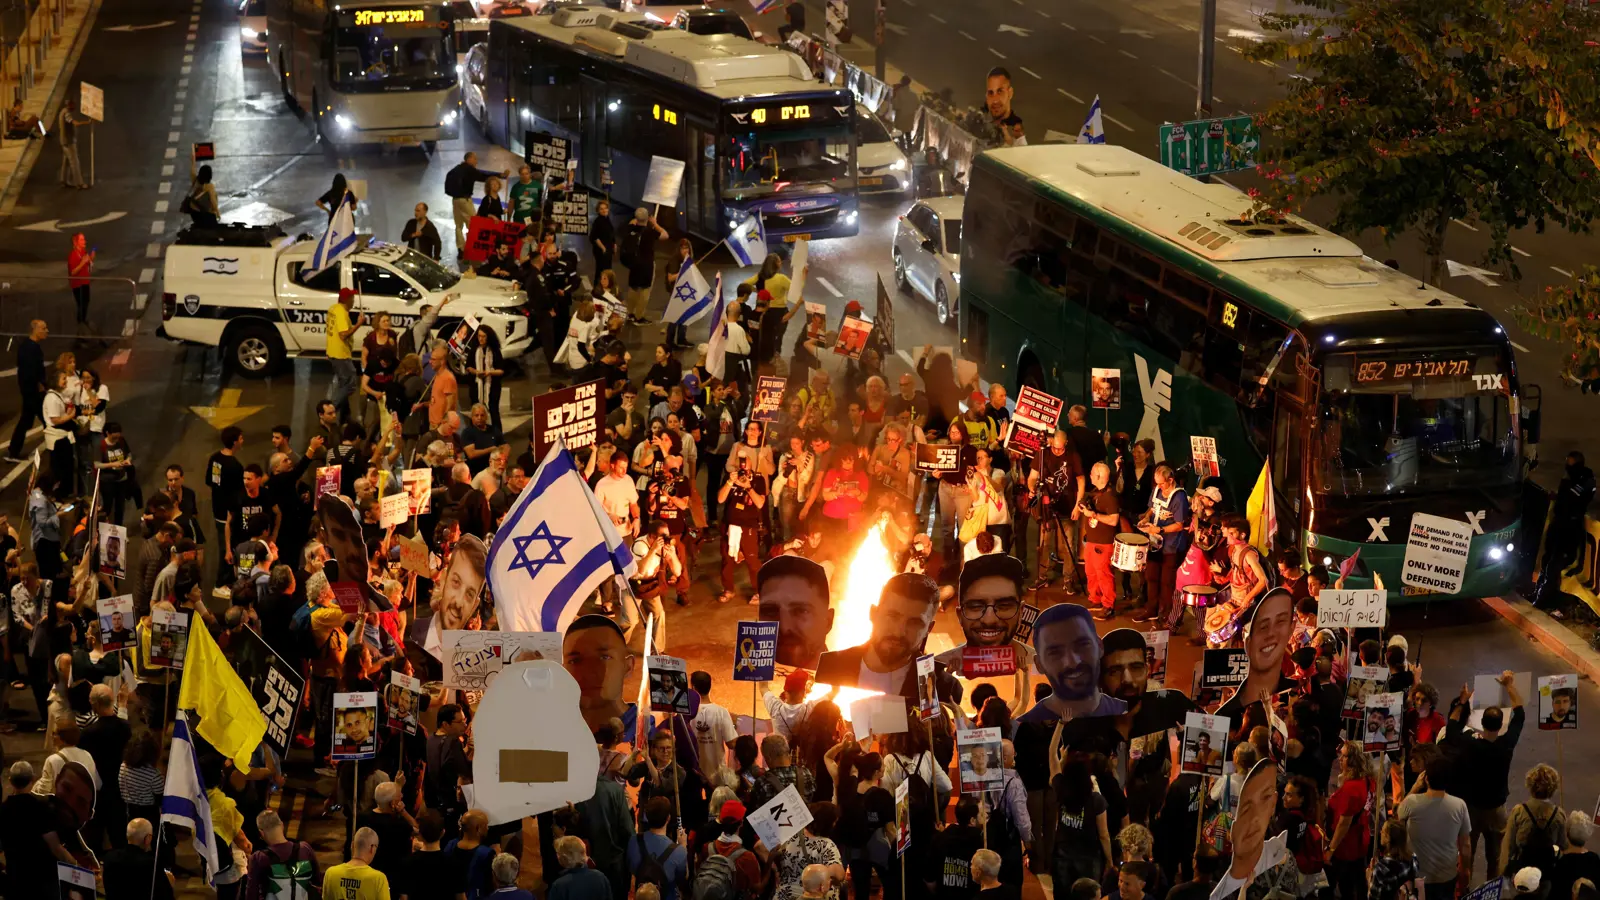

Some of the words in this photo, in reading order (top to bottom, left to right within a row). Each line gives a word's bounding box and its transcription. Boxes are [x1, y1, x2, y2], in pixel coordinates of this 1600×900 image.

[751, 108, 767, 124] 40
[552, 137, 566, 147] את
[533, 142, 566, 161] כולם
[572, 193, 587, 202] את
[552, 200, 587, 215] כולם
[1223, 302, 1238, 328] 852
[1357, 361, 1387, 382] 852
[1394, 362, 1411, 378] יפו
[1412, 361, 1446, 377] אביב
[1448, 359, 1469, 375] תל
[1471, 373, 1504, 391] אגד
[575, 383, 597, 400] את
[547, 396, 597, 429] כולם
[1029, 409, 1041, 419] FOR
[1040, 413, 1055, 424] HELP
[543, 417, 597, 444] בפעימה
[936, 454, 957, 464] כל
[1414, 523, 1424, 531] THE
[1426, 526, 1450, 537] DEMAND
[1452, 532, 1464, 540] FOR
[1495, 528, 1516, 541] 77917
[1409, 539, 1428, 548] NEEDS
[1430, 543, 1440, 551] NO
[1442, 546, 1467, 557] DEFENSE
[1430, 535, 1454, 546] HOSTAGE
[1455, 541, 1468, 549] DEAL
[1408, 559, 1433, 572] ONLY
[1434, 564, 1460, 578] MORE
[1406, 573, 1457, 591] DEFENDERS
[1366, 592, 1380, 607] תן
[741, 626, 757, 636] הרוב
[758, 626, 776, 635] אנחנו
[757, 640, 774, 650] בעד
[749, 649, 774, 659] עסקת
[741, 658, 773, 667] חטופים
[1228, 660, 1249, 675] כל
[267, 666, 298, 703] קודם
[262, 679, 293, 730] כל
[943, 874, 968, 889] NOW!
